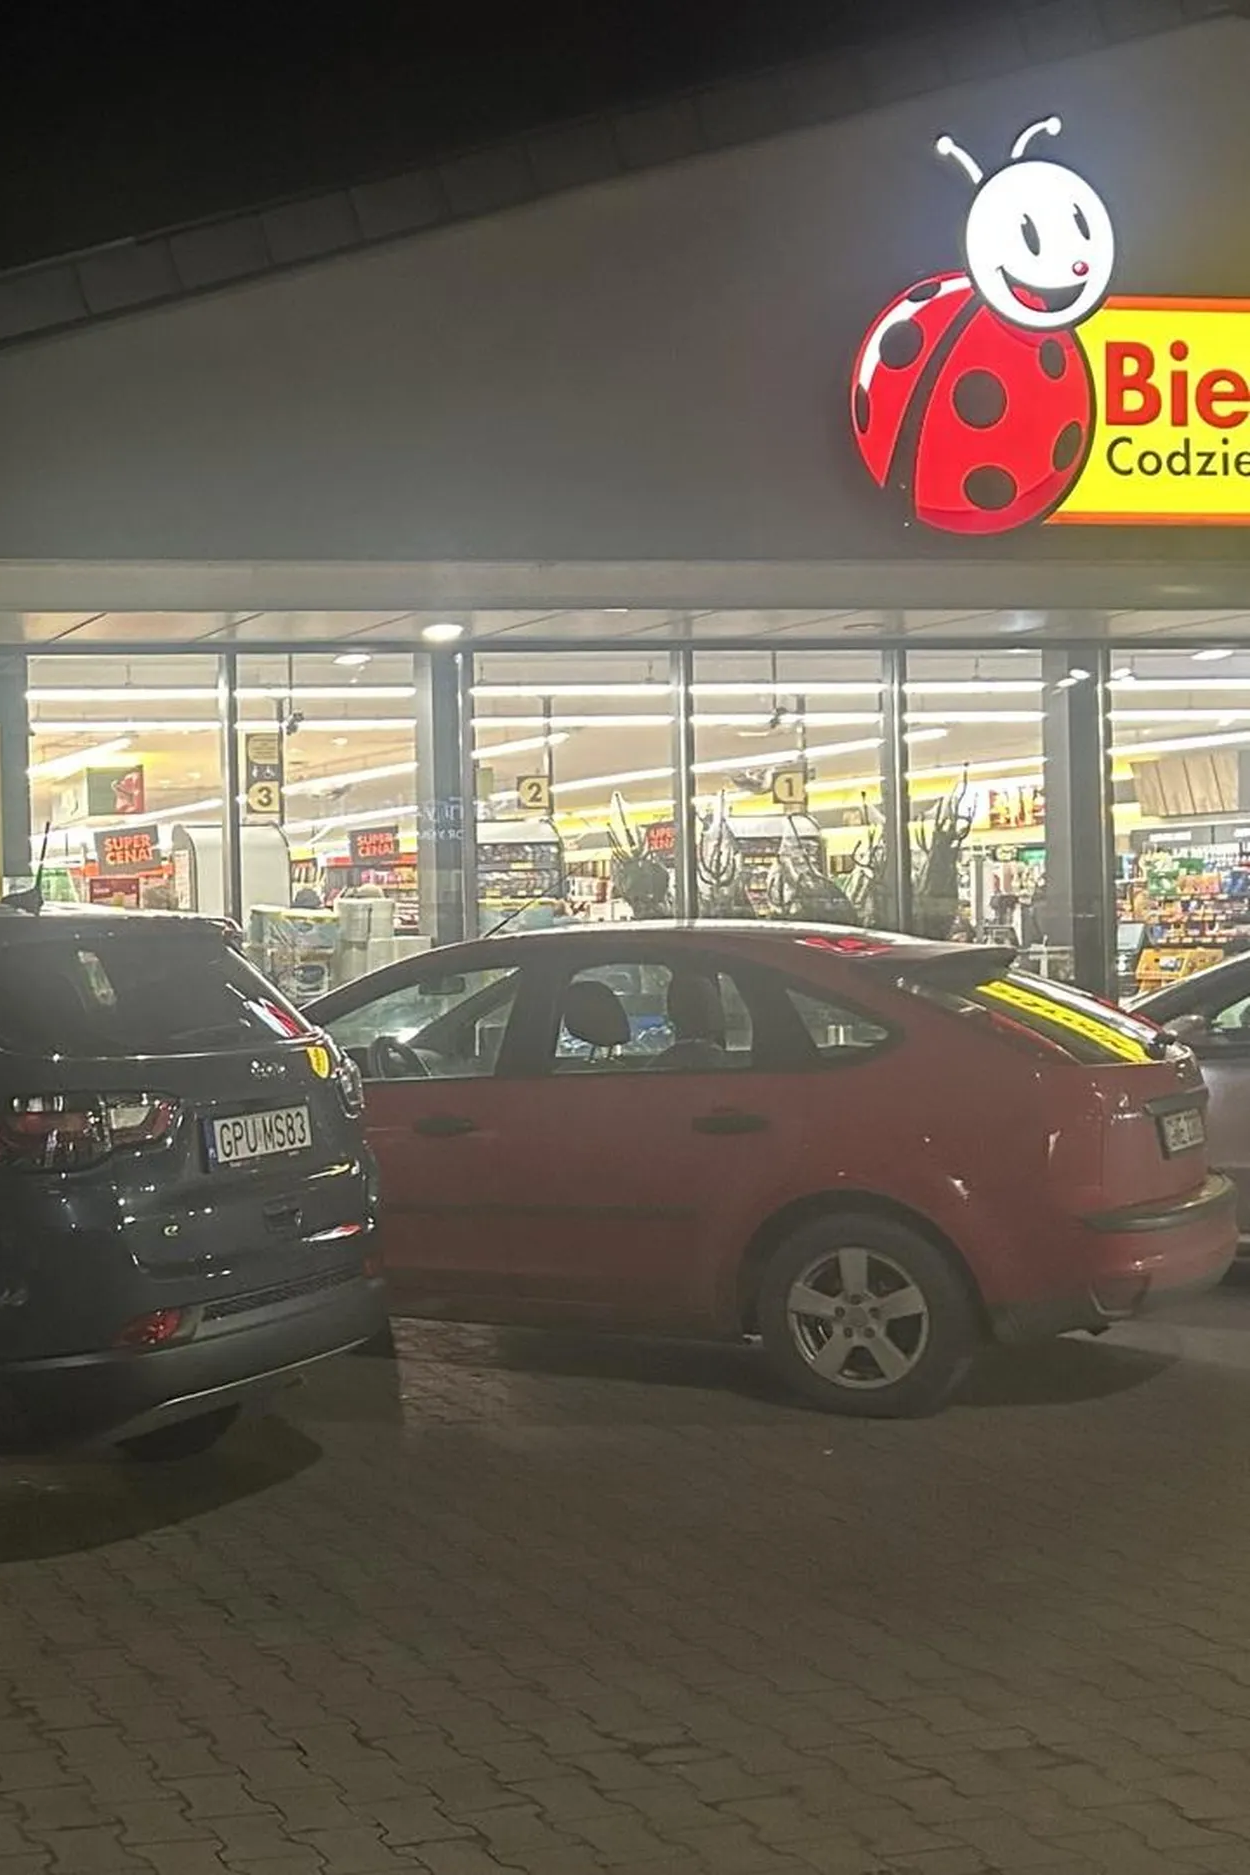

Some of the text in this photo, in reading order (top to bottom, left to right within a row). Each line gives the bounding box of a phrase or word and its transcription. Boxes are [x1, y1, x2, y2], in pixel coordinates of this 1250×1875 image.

[1105, 340, 1250, 429] Bie
[1106, 436, 1250, 476] Codzie
[257, 786, 272, 807] 3
[527, 782, 543, 802] 2
[785, 777, 794, 797] 1
[104, 833, 152, 852] SUPER
[220, 1119, 258, 1158] GPU
